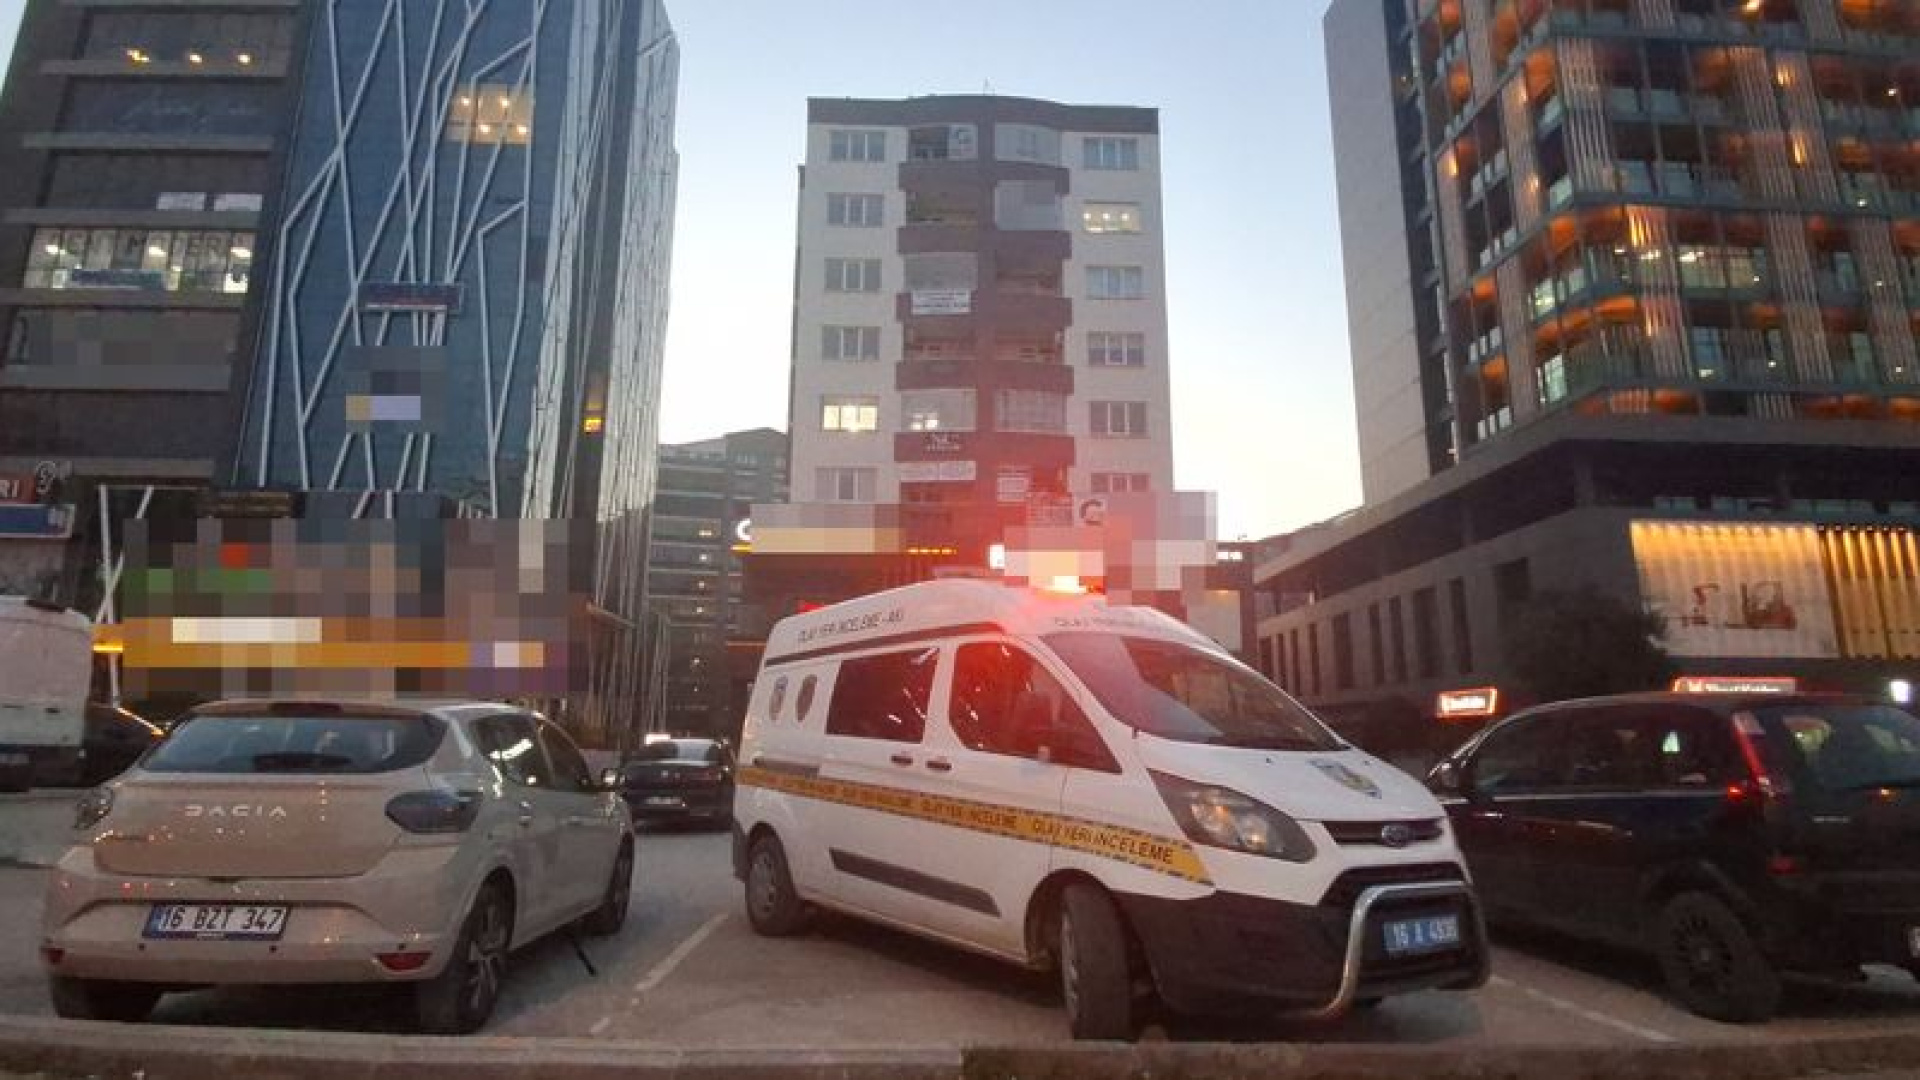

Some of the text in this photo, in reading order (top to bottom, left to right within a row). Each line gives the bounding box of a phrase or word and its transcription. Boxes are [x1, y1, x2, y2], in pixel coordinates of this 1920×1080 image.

[184, 805, 287, 817] DACIA
[162, 906, 283, 930] 16 BZT 347
